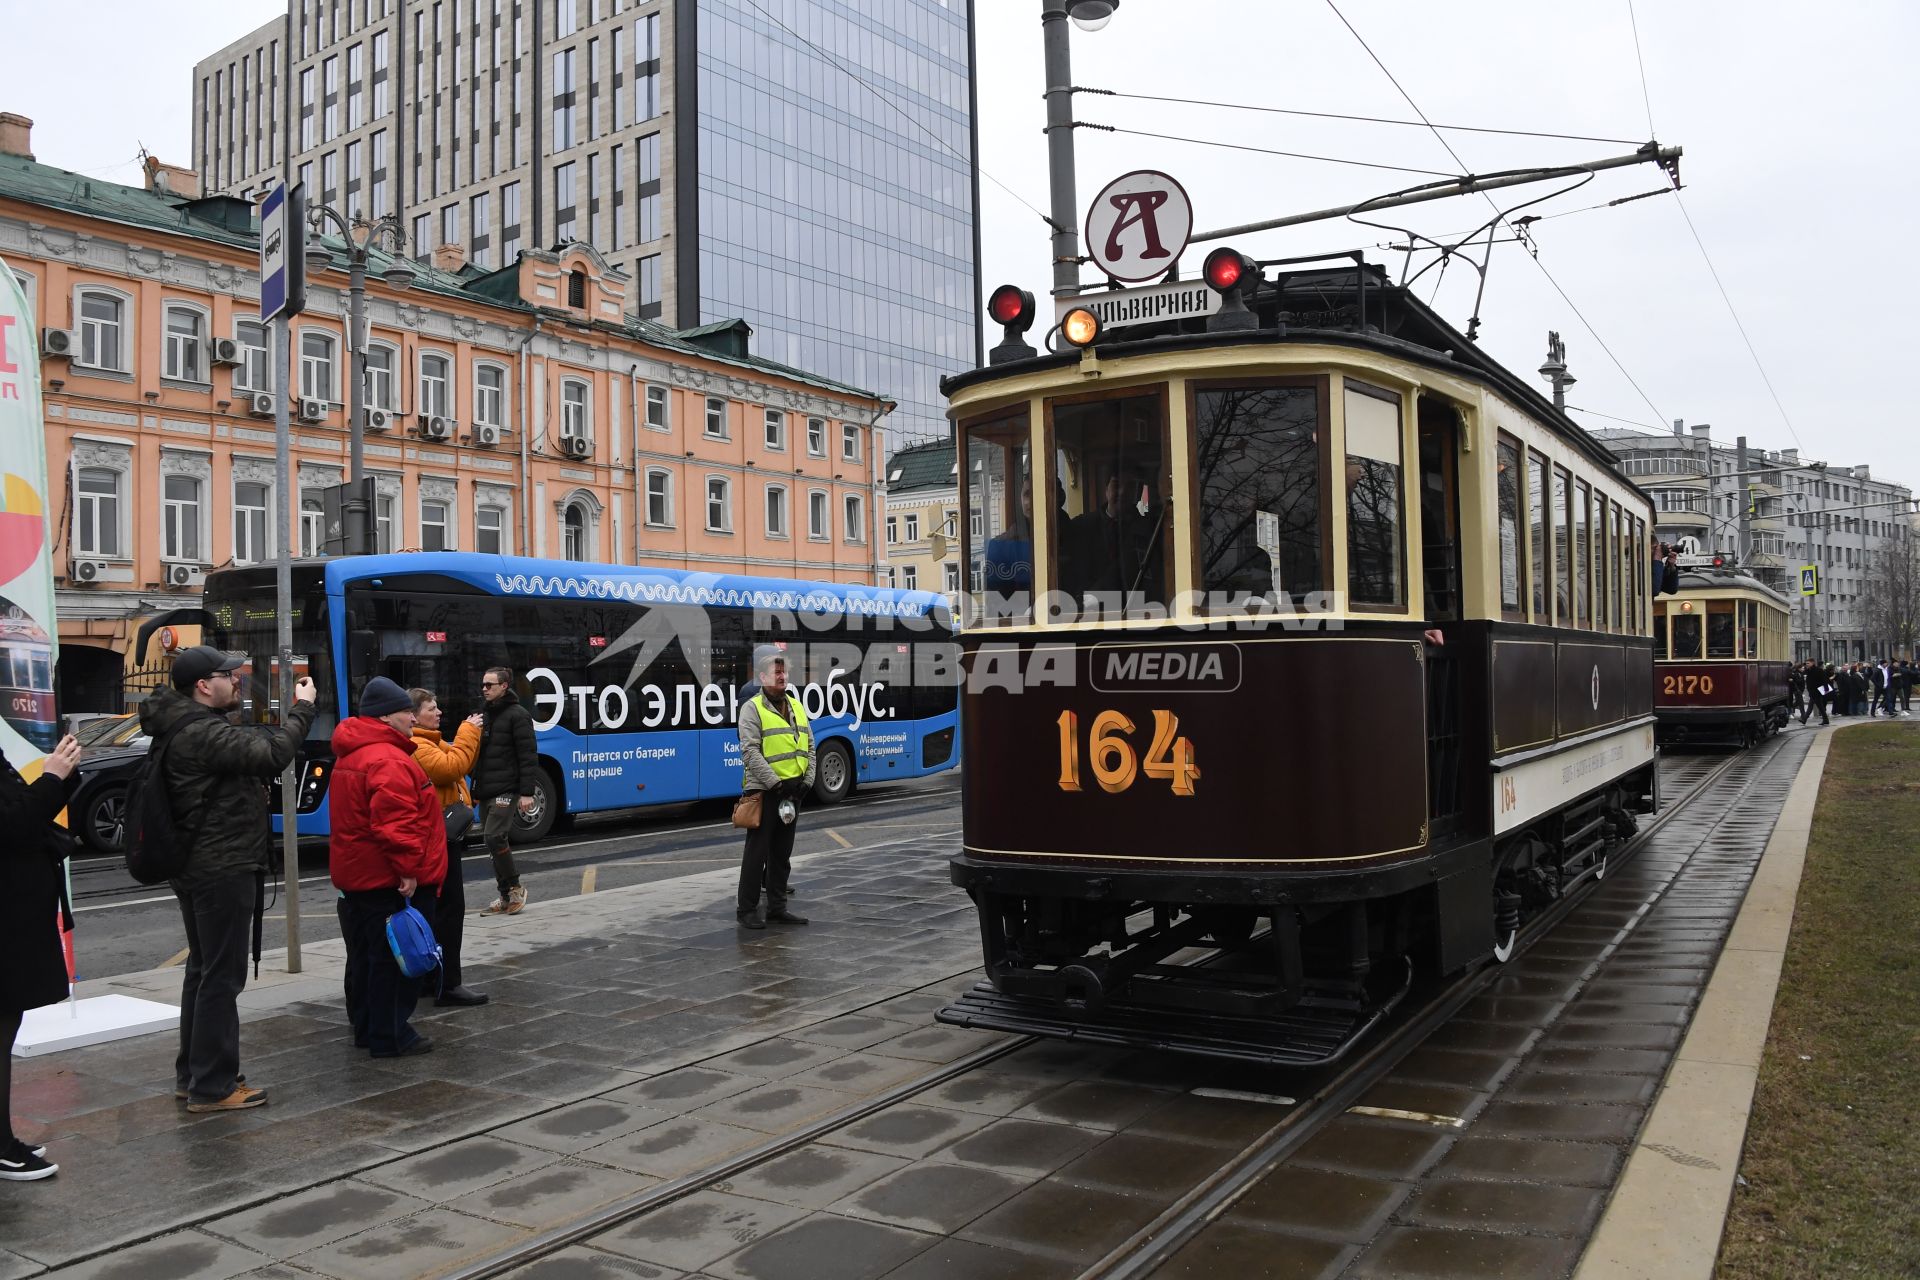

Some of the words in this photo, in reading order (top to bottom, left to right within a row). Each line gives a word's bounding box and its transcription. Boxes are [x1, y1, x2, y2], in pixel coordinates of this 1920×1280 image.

[1105, 190, 1171, 262] А
[1084, 289, 1208, 324] ЛЬВАРНАЯ
[1663, 675, 1713, 695] 2170
[525, 667, 629, 732] Это
[641, 668, 896, 732] элеобус.
[860, 731, 907, 745] Маневренный
[865, 744, 904, 757] бесшумный
[572, 750, 621, 763] Питается
[623, 749, 633, 760] от
[635, 746, 676, 761] батареи
[1057, 709, 1201, 796] 164
[572, 767, 585, 779] на
[588, 765, 623, 780] крыше
[1501, 775, 1516, 814] 164
